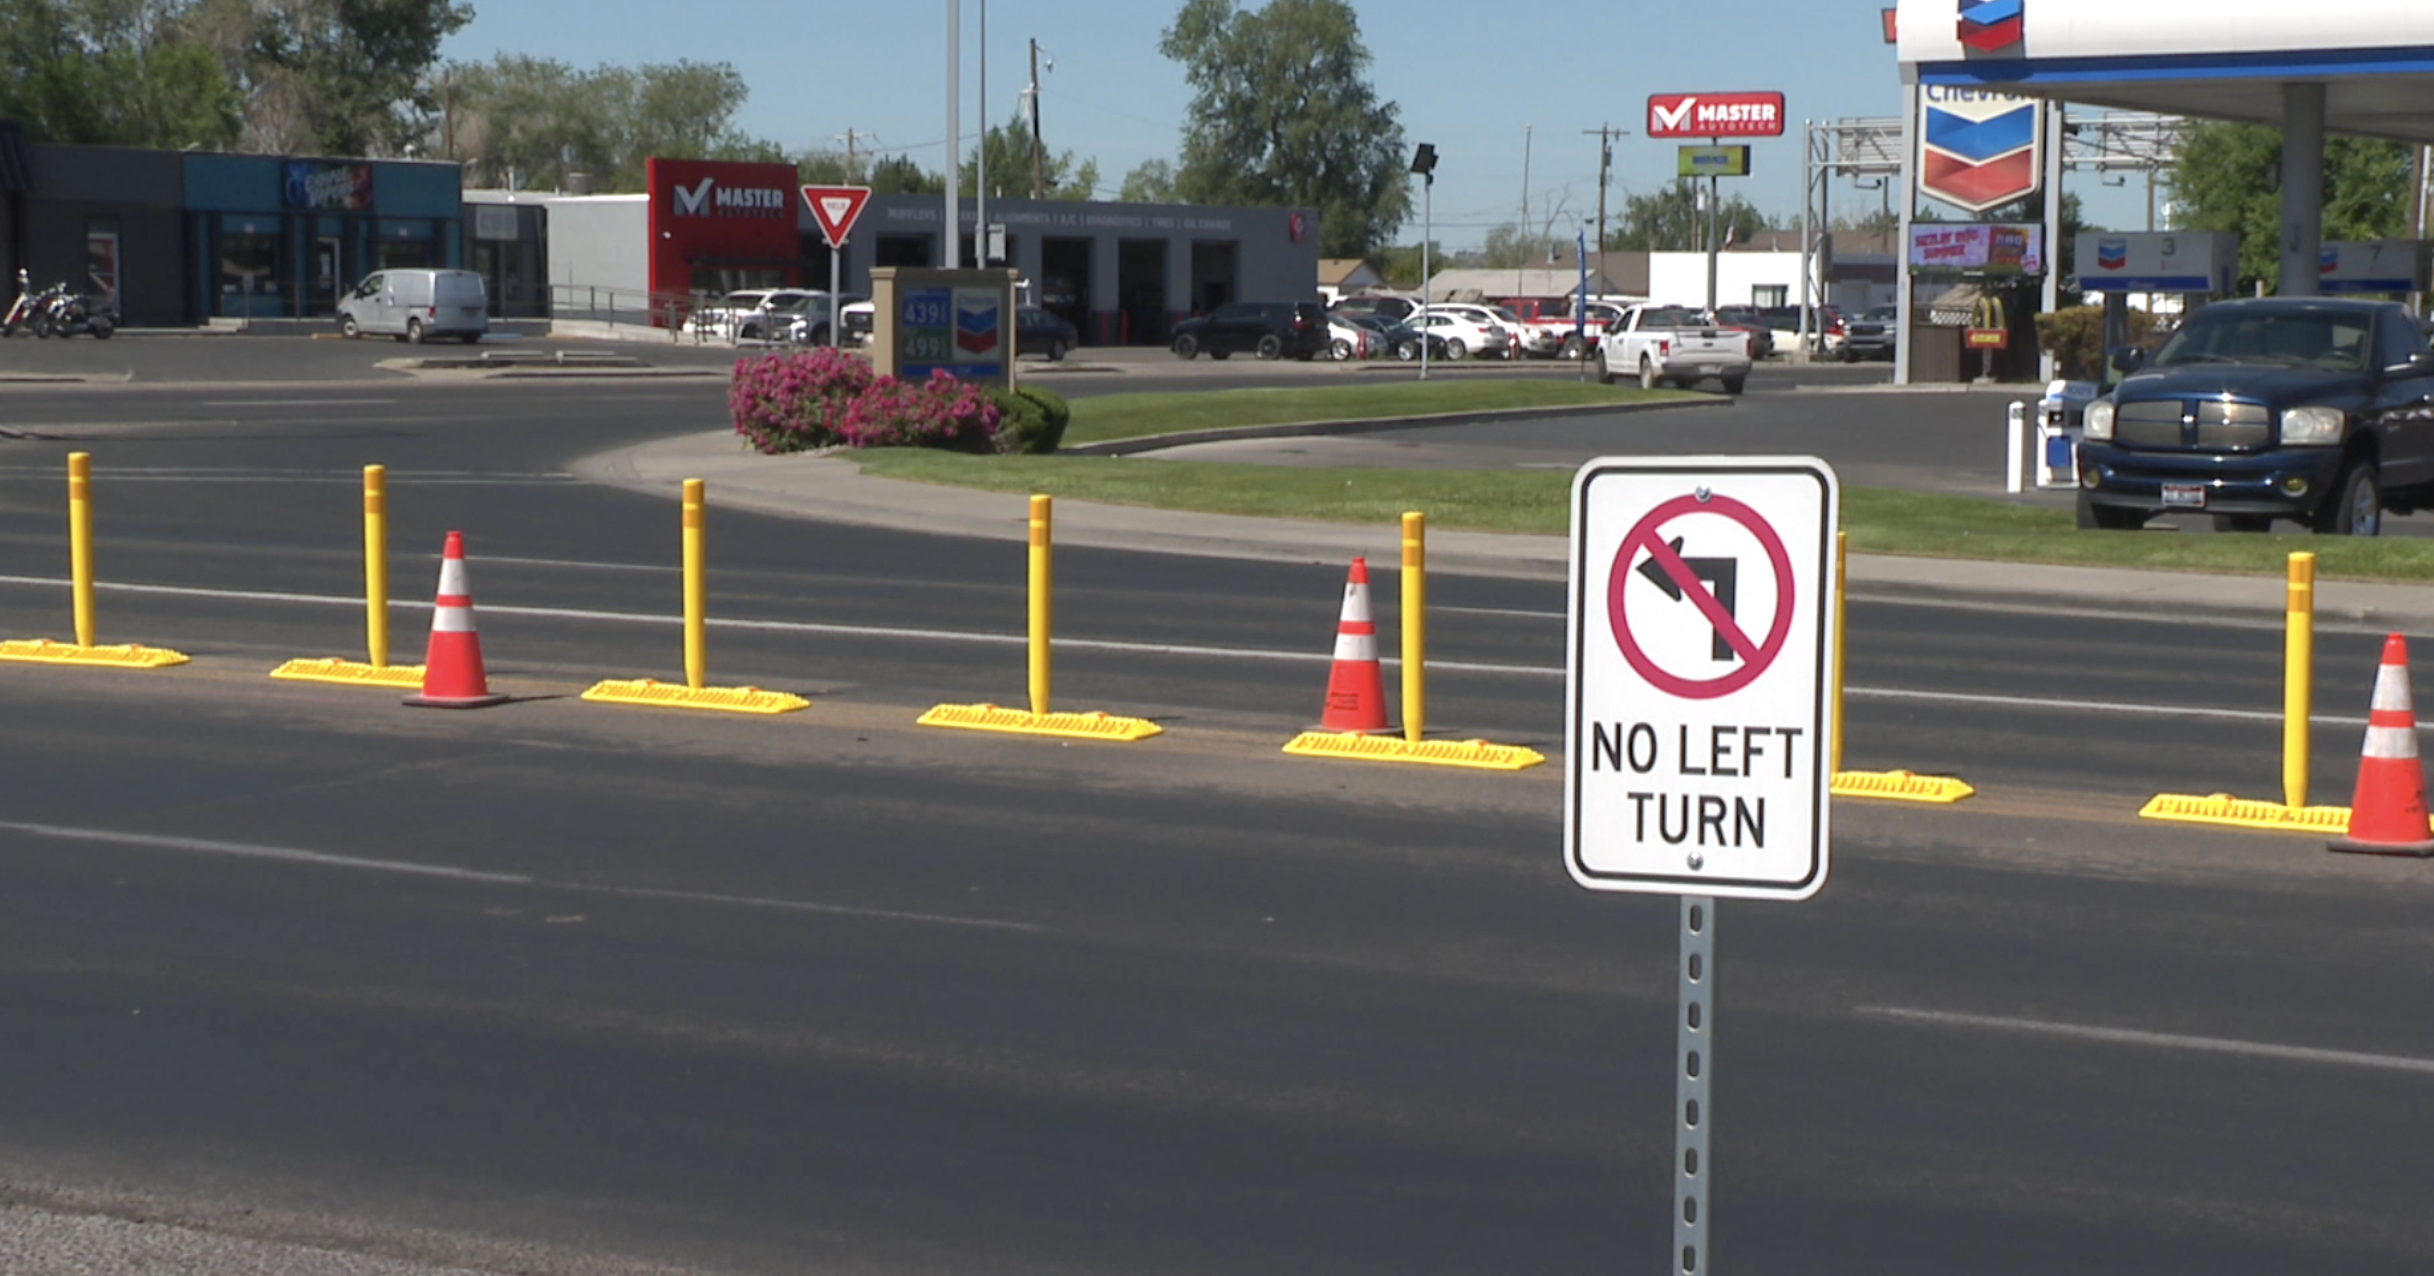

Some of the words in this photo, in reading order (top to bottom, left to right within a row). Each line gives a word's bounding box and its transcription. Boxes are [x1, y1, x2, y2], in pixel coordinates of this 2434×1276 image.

[1698, 104, 1776, 122] MASTER
[1698, 122, 1776, 131] AUTOTECH
[716, 187, 784, 208] MASTER
[2162, 237, 2176, 256] 3
[2370, 244, 2384, 263] 7
[1593, 721, 1658, 774] NO
[1679, 724, 1803, 779] LEFT
[1627, 791, 1765, 849] TURN
